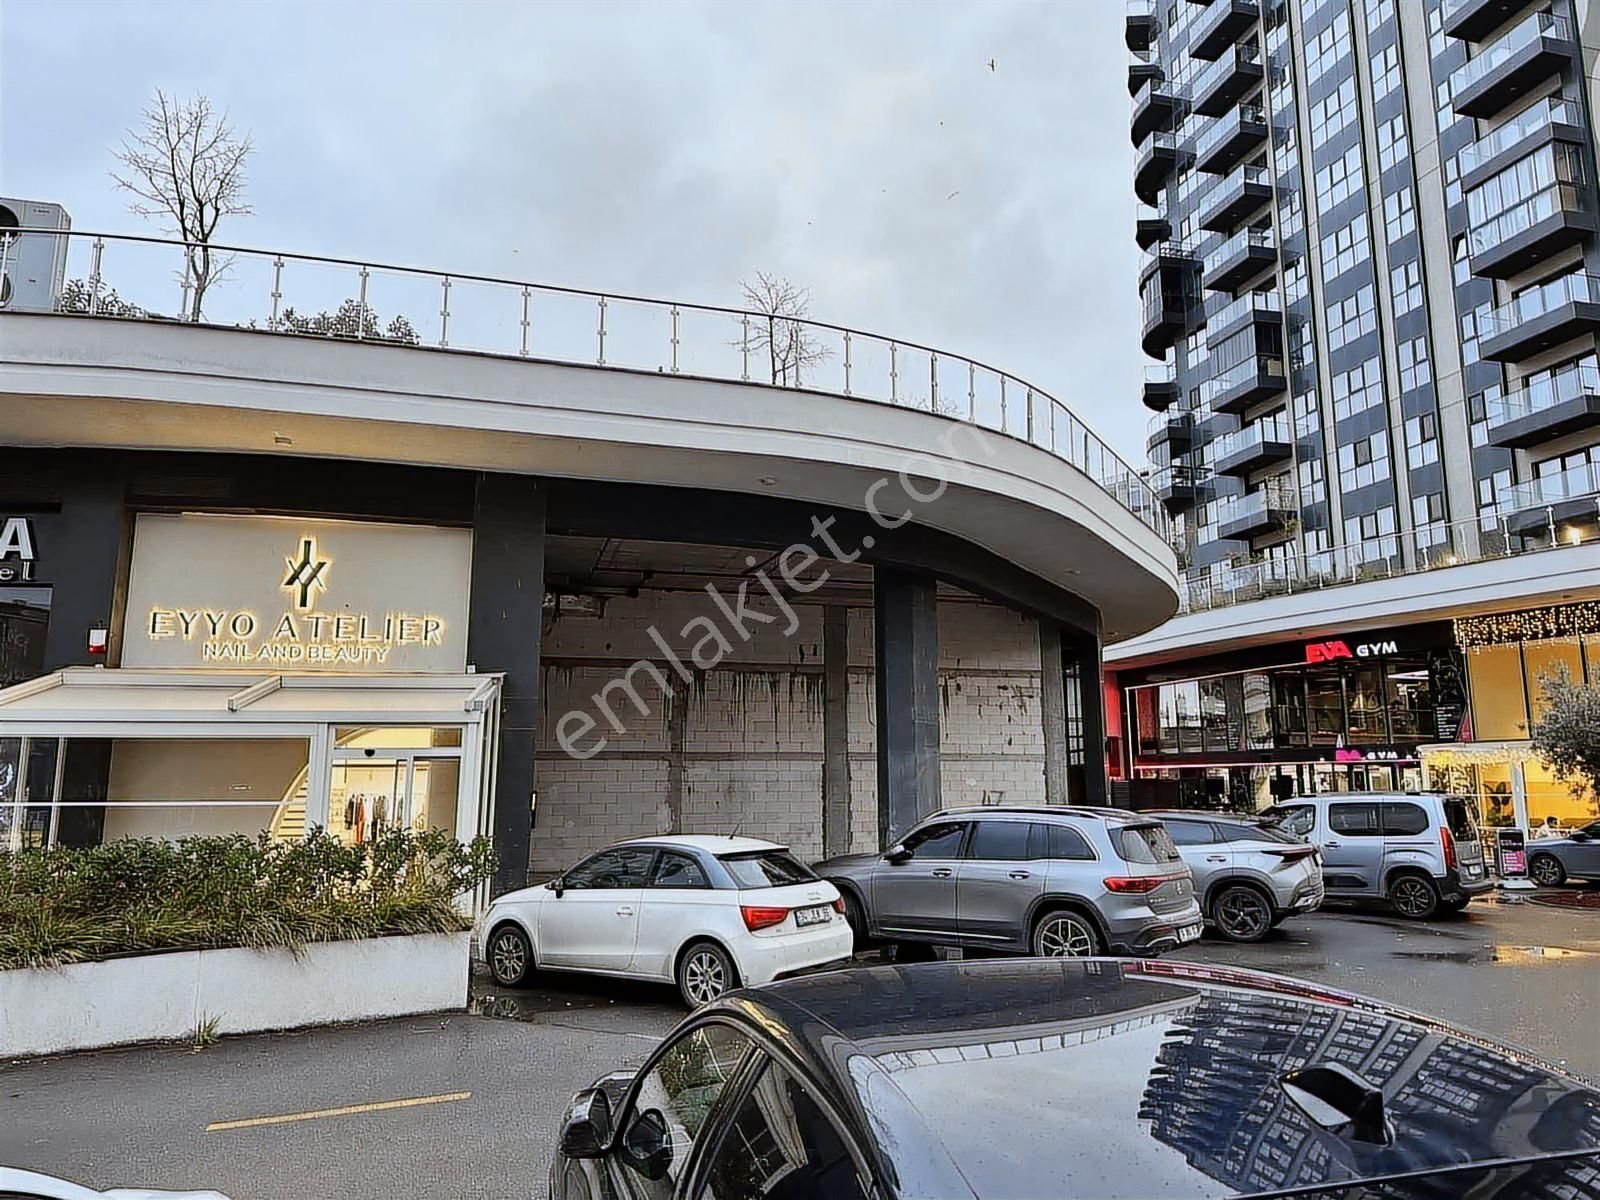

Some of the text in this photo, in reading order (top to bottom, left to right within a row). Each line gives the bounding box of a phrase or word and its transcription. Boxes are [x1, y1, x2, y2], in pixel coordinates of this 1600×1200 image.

[149, 610, 442, 643] EYYO ATELIER
[202, 643, 390, 662] NAIL AND BEAUTY
[1305, 640, 1398, 664] EVA GYM
